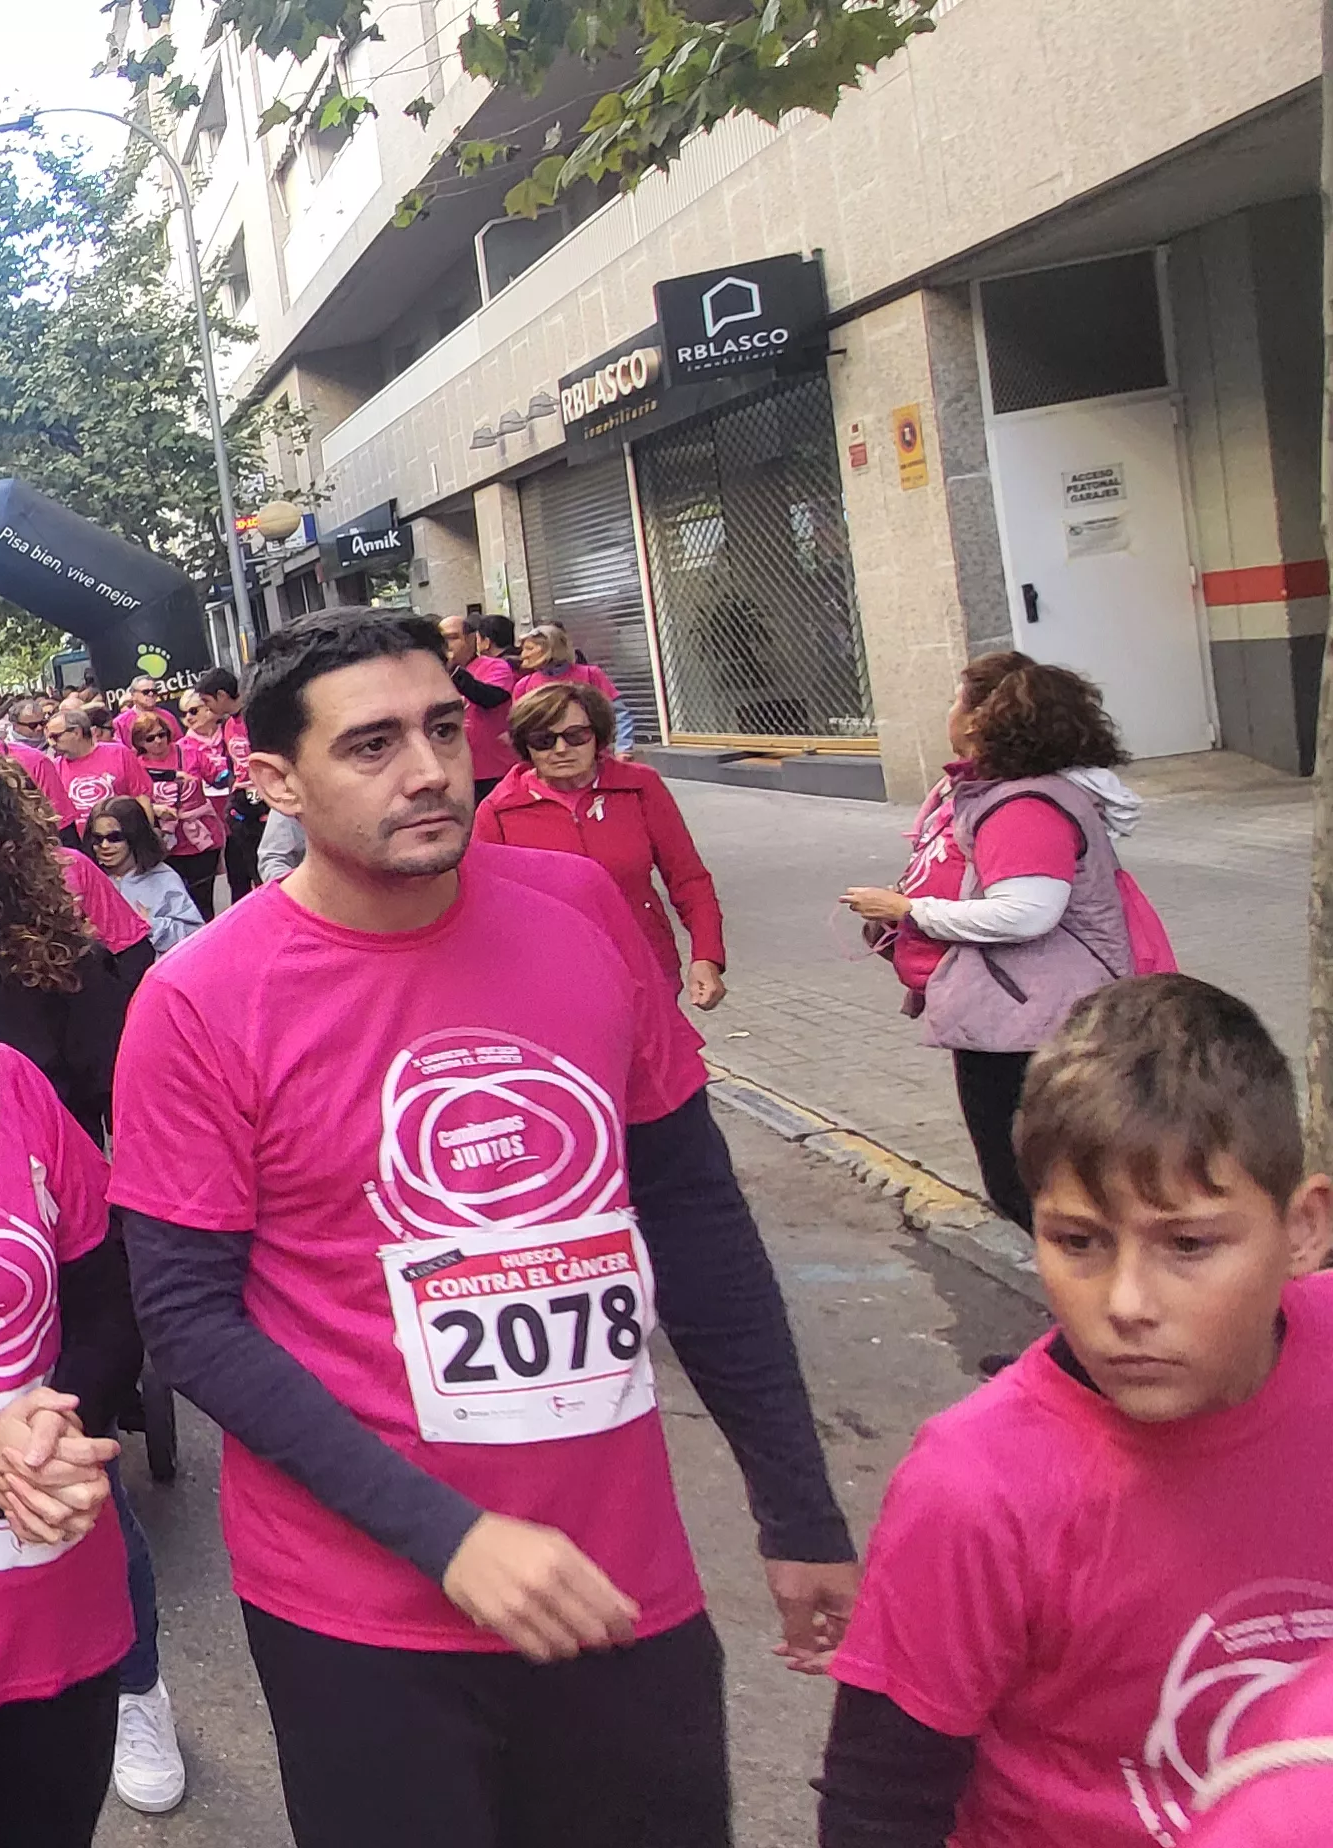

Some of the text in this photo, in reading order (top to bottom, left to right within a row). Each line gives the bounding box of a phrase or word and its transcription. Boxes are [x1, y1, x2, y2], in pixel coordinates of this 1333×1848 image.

[676, 328, 789, 364] RBLASCO
[561, 349, 650, 425] RBLASCO
[29, 544, 64, 575] bien,
[66, 565, 96, 589] vive
[94, 581, 142, 611] mejor
[449, 1135, 526, 1171] JUNTOS
[424, 1252, 632, 1299] CONTRA EL CÁNCER
[498, 1247, 566, 1269] HUESCA
[430, 1284, 642, 1384] 2078
